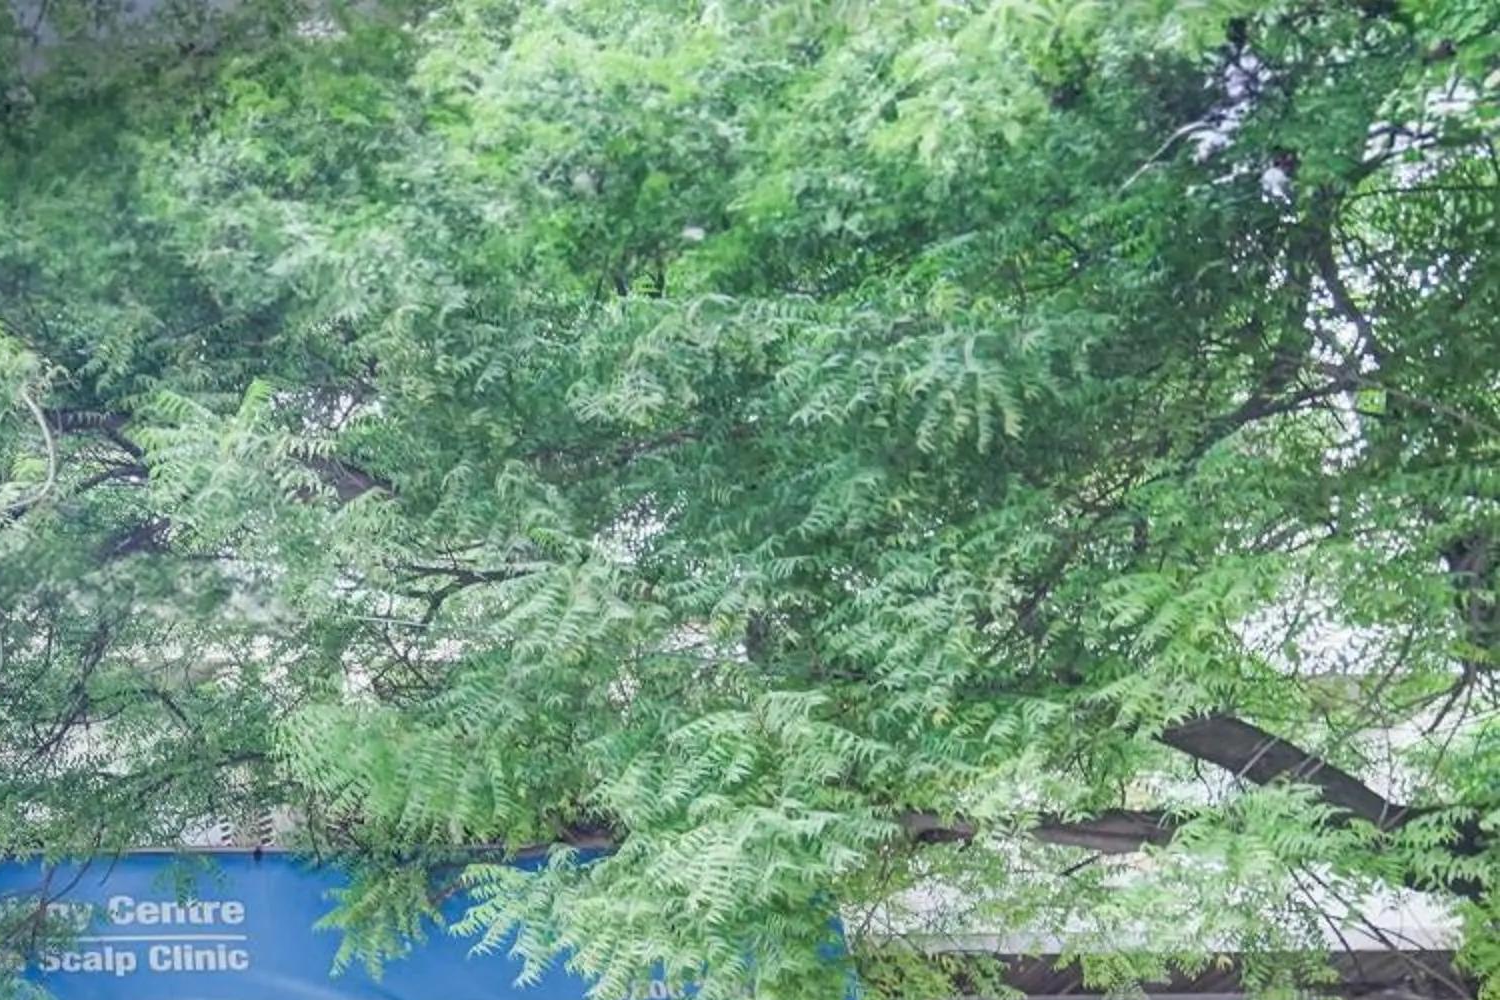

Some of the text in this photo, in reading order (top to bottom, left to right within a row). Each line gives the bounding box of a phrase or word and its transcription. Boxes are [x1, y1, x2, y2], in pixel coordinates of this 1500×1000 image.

[108, 895, 246, 926] Centre
[39, 944, 137, 977] Scalp
[150, 943, 250, 972] Clinic
